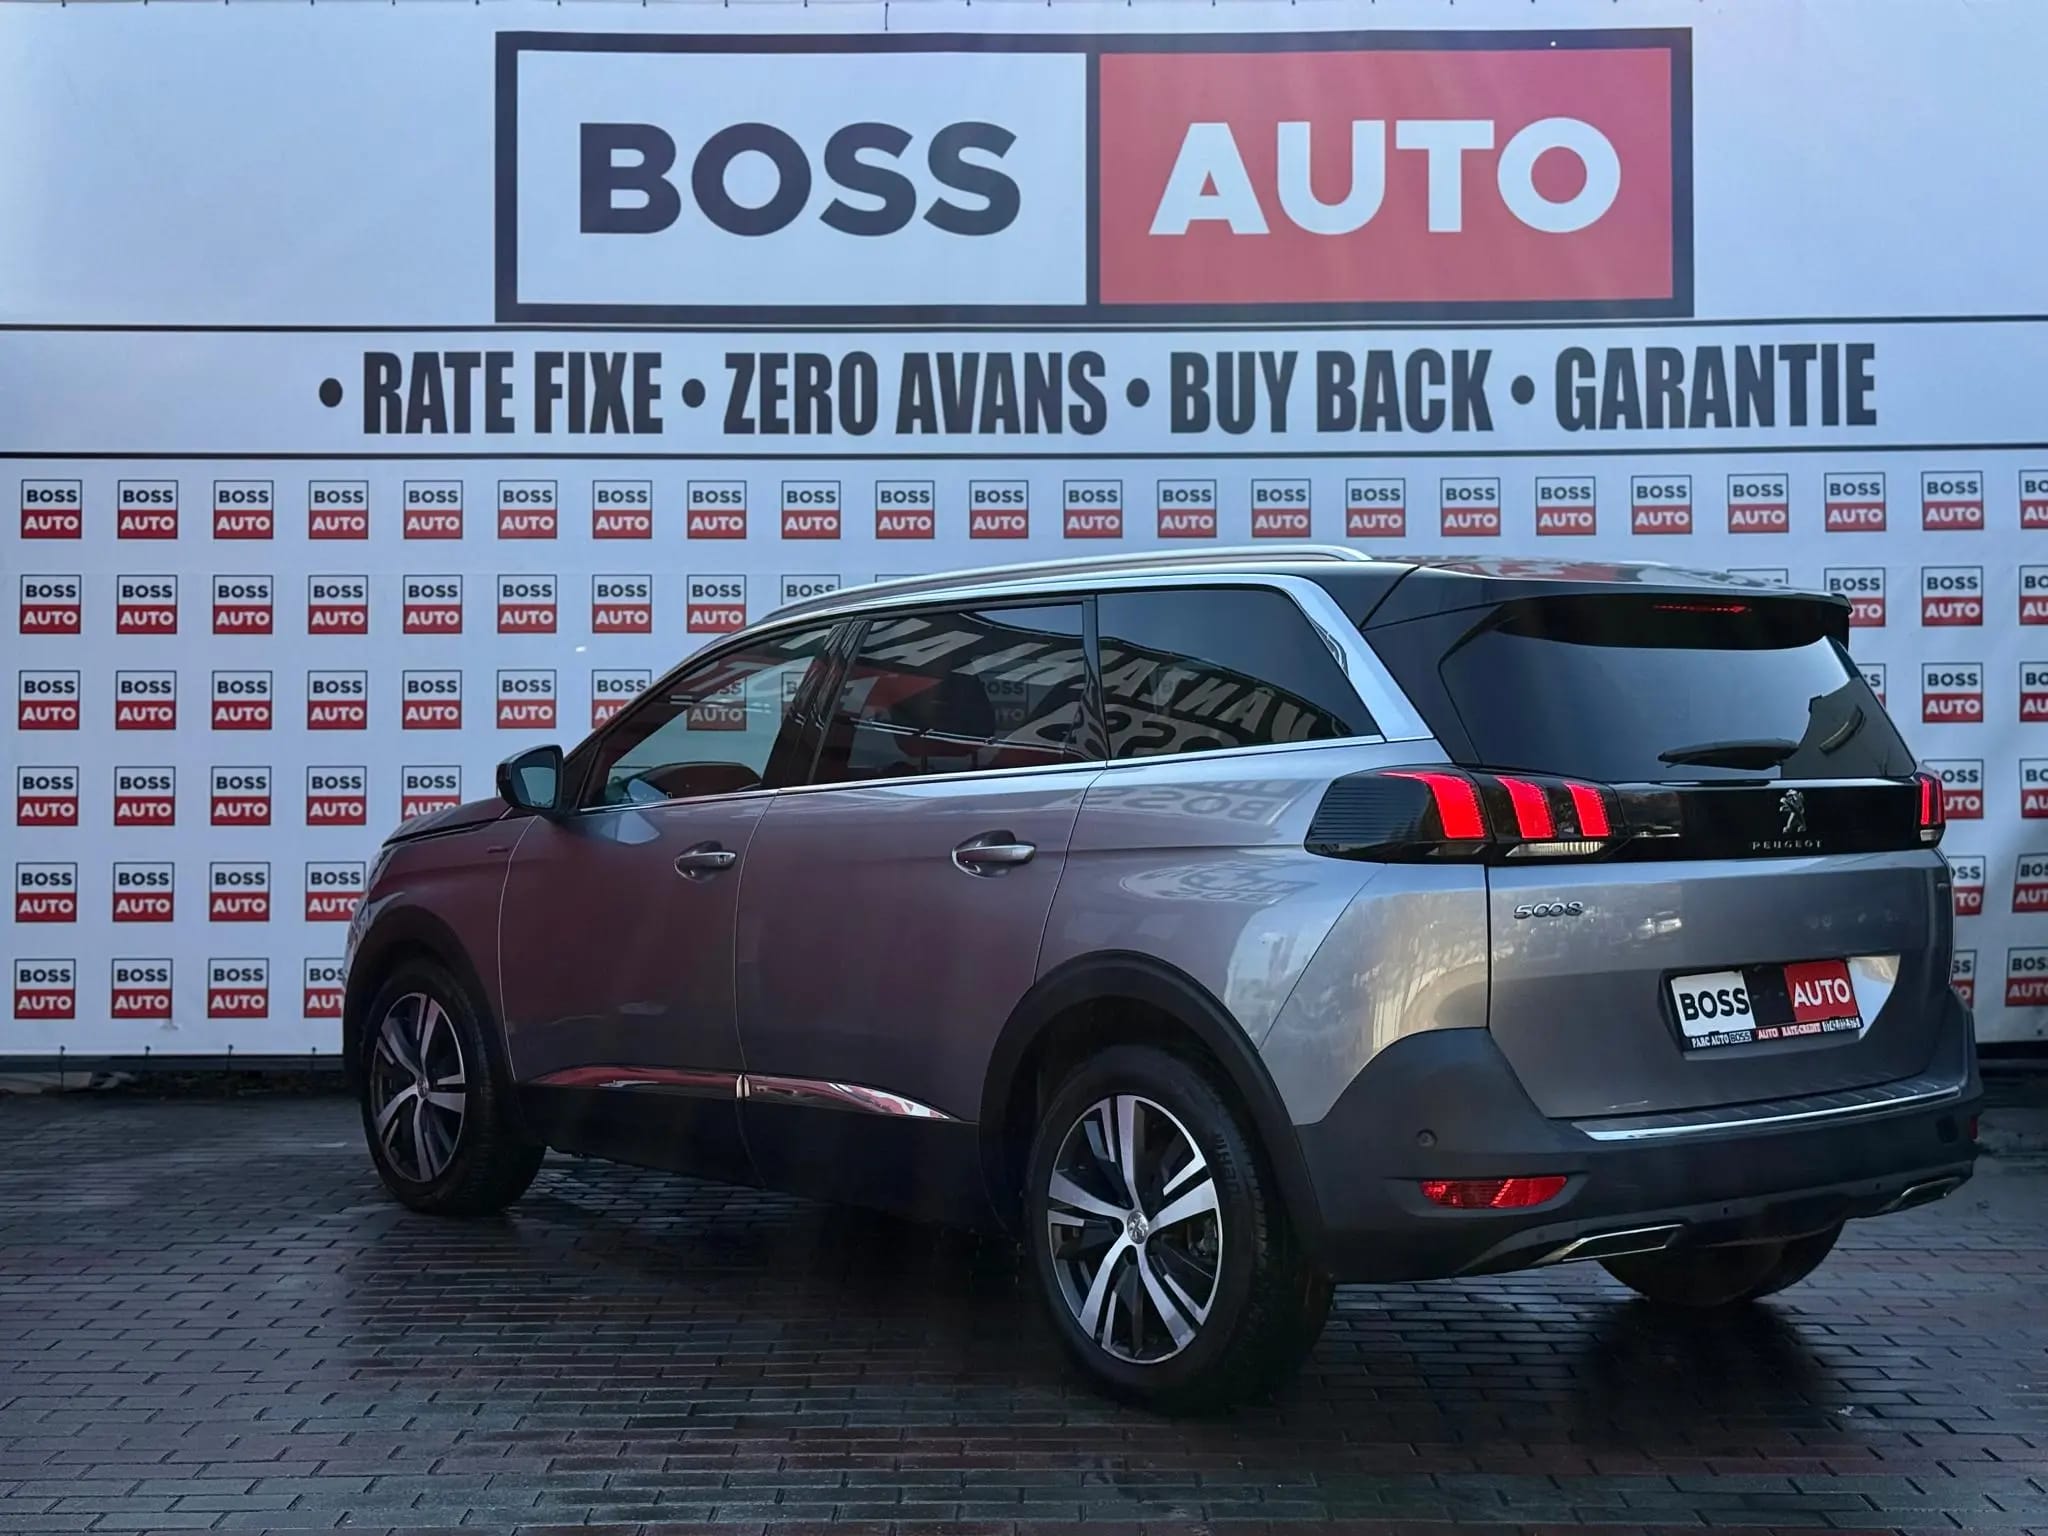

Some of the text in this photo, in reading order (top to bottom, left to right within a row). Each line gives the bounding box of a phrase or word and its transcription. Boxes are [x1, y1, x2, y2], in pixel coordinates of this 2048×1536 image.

[579, 117, 1621, 237] BOSS AUTO
[363, 343, 1877, 436] RATE FIXE ZERO AVANS BUY BACK GARANTIE
[1637, 485, 1687, 499] BOSS
[1733, 484, 1784, 498] BOSS
[1830, 482, 1881, 496] BOSS
[1927, 481, 1978, 495] BOSS
[2024, 479, 2048, 493] BO
[27, 489, 77, 503] BOSS
[123, 490, 173, 504] BOSS
[219, 490, 269, 504] BOSS
[314, 490, 364, 504] BOSS
[409, 490, 458, 504] BOSS
[503, 490, 552, 504] BOSS
[598, 490, 647, 504] BOSS
[693, 490, 742, 504] BOSS
[787, 490, 836, 504] BOSS
[881, 490, 930, 504] BOSS
[975, 490, 1024, 504] BOSS
[1069, 490, 1118, 503] BOSS
[1163, 489, 1212, 503] BOSS
[1257, 489, 1306, 502] BOSS
[1351, 488, 1401, 502] BOSS
[1446, 488, 1495, 501] BOSS
[1541, 487, 1591, 500] BOSS
[1539, 513, 1592, 527] AUTO
[1635, 512, 1688, 526] AUTO
[1731, 511, 1786, 524] AUTO
[1828, 509, 1883, 523] AUTO
[1925, 508, 1980, 522] AUTO
[2024, 506, 2048, 520] AU
[25, 516, 78, 530] AUTO
[121, 517, 174, 530] AUTO
[217, 517, 270, 530] AUTO
[312, 517, 365, 530] AUTO
[407, 517, 459, 530] AUTO
[501, 517, 553, 530] AUTO
[596, 517, 648, 530] AUTO
[691, 517, 743, 530] AUTO
[785, 517, 837, 530] AUTO
[879, 517, 931, 530] AUTO
[973, 517, 1025, 530] AUTO
[1067, 516, 1119, 530] AUTO
[1161, 516, 1213, 530] AUTO
[1255, 515, 1307, 529] AUTO
[1349, 515, 1402, 528] AUTO
[1444, 514, 1496, 528] AUTO
[1830, 577, 1880, 591] BOSS
[1927, 576, 1978, 590] BOSS
[2024, 575, 2048, 589] BO
[26, 584, 76, 598] BOSS
[122, 585, 172, 599] BOSS
[218, 585, 268, 599] BOSS
[314, 585, 363, 599] BOSS
[408, 584, 458, 598] BOSS
[503, 584, 552, 598] BOSS
[598, 584, 647, 598] BOSS
[692, 584, 741, 598] BOSS
[1925, 603, 1980, 617] AUTO
[2022, 602, 2048, 617] AU
[24, 611, 77, 625] AUTO
[120, 612, 173, 626] AUTO
[216, 612, 269, 626] AUTO
[312, 612, 364, 626] AUTO
[406, 611, 459, 625] AUTO
[501, 611, 553, 624] AUTO
[596, 611, 648, 624] AUTO
[690, 611, 742, 624] AUTO
[502, 679, 551, 693] BOSS
[1928, 673, 1978, 687] BOSS
[2025, 672, 2048, 686] BO
[24, 680, 74, 694] BOSS
[121, 680, 171, 694] BOSS
[217, 680, 267, 694] BOSS
[313, 680, 362, 694] BOSS
[408, 680, 457, 694] BOSS
[596, 680, 646, 693] BOSS
[311, 707, 363, 720] AUTO
[406, 707, 458, 720] AUTO
[500, 706, 552, 720] AUTO
[1926, 700, 1979, 714] AUTO
[2023, 699, 2048, 714] AU
[22, 707, 75, 721] AUTO
[119, 707, 172, 721] AUTO
[215, 707, 268, 721] AUTO
[690, 708, 743, 722] AUTO
[23, 776, 73, 790] BOSS
[120, 776, 170, 790] BOSS
[216, 776, 266, 790] BOSS
[312, 776, 361, 790] BOSS
[407, 775, 456, 788] BOSS
[1940, 769, 1979, 783] OSS
[2026, 769, 2048, 783] BO
[21, 803, 74, 817] AUTO
[118, 803, 171, 816] AUTO
[214, 803, 267, 816] AUTO
[310, 803, 362, 816] AUTO
[1944, 796, 1980, 810] UTO
[2025, 796, 2048, 810] AU
[1752, 840, 1823, 850] PEUGEOT
[21, 872, 72, 886] BOSS
[118, 872, 169, 886] BOSS
[215, 872, 265, 886] BOSS
[311, 871, 360, 885] BOSS
[1956, 892, 1980, 907] TO
[2016, 889, 2048, 904] AUT
[19, 899, 74, 913] AUTO
[116, 899, 171, 913] AUTO
[213, 899, 266, 912] AUTO
[1513, 901, 1583, 919] 5008
[1951, 959, 1971, 974] SS
[2012, 957, 2048, 971] BOS
[20, 969, 70, 983] BOSS
[117, 968, 167, 982] BOSS
[213, 968, 263, 982] BOSS
[309, 968, 344, 981] BOS
[18, 996, 71, 1010] AUTO
[115, 995, 168, 1009] AUTO
[211, 995, 264, 1009] AUTO
[307, 996, 343, 1009] AUT
[1679, 978, 1850, 1021] BOSS AUTO
[1691, 1037, 1710, 1049] PARC
[1711, 1034, 1730, 1046] AUTO
[1730, 1031, 1751, 1043] BOSS
[1758, 1027, 1779, 1040] AUTO
